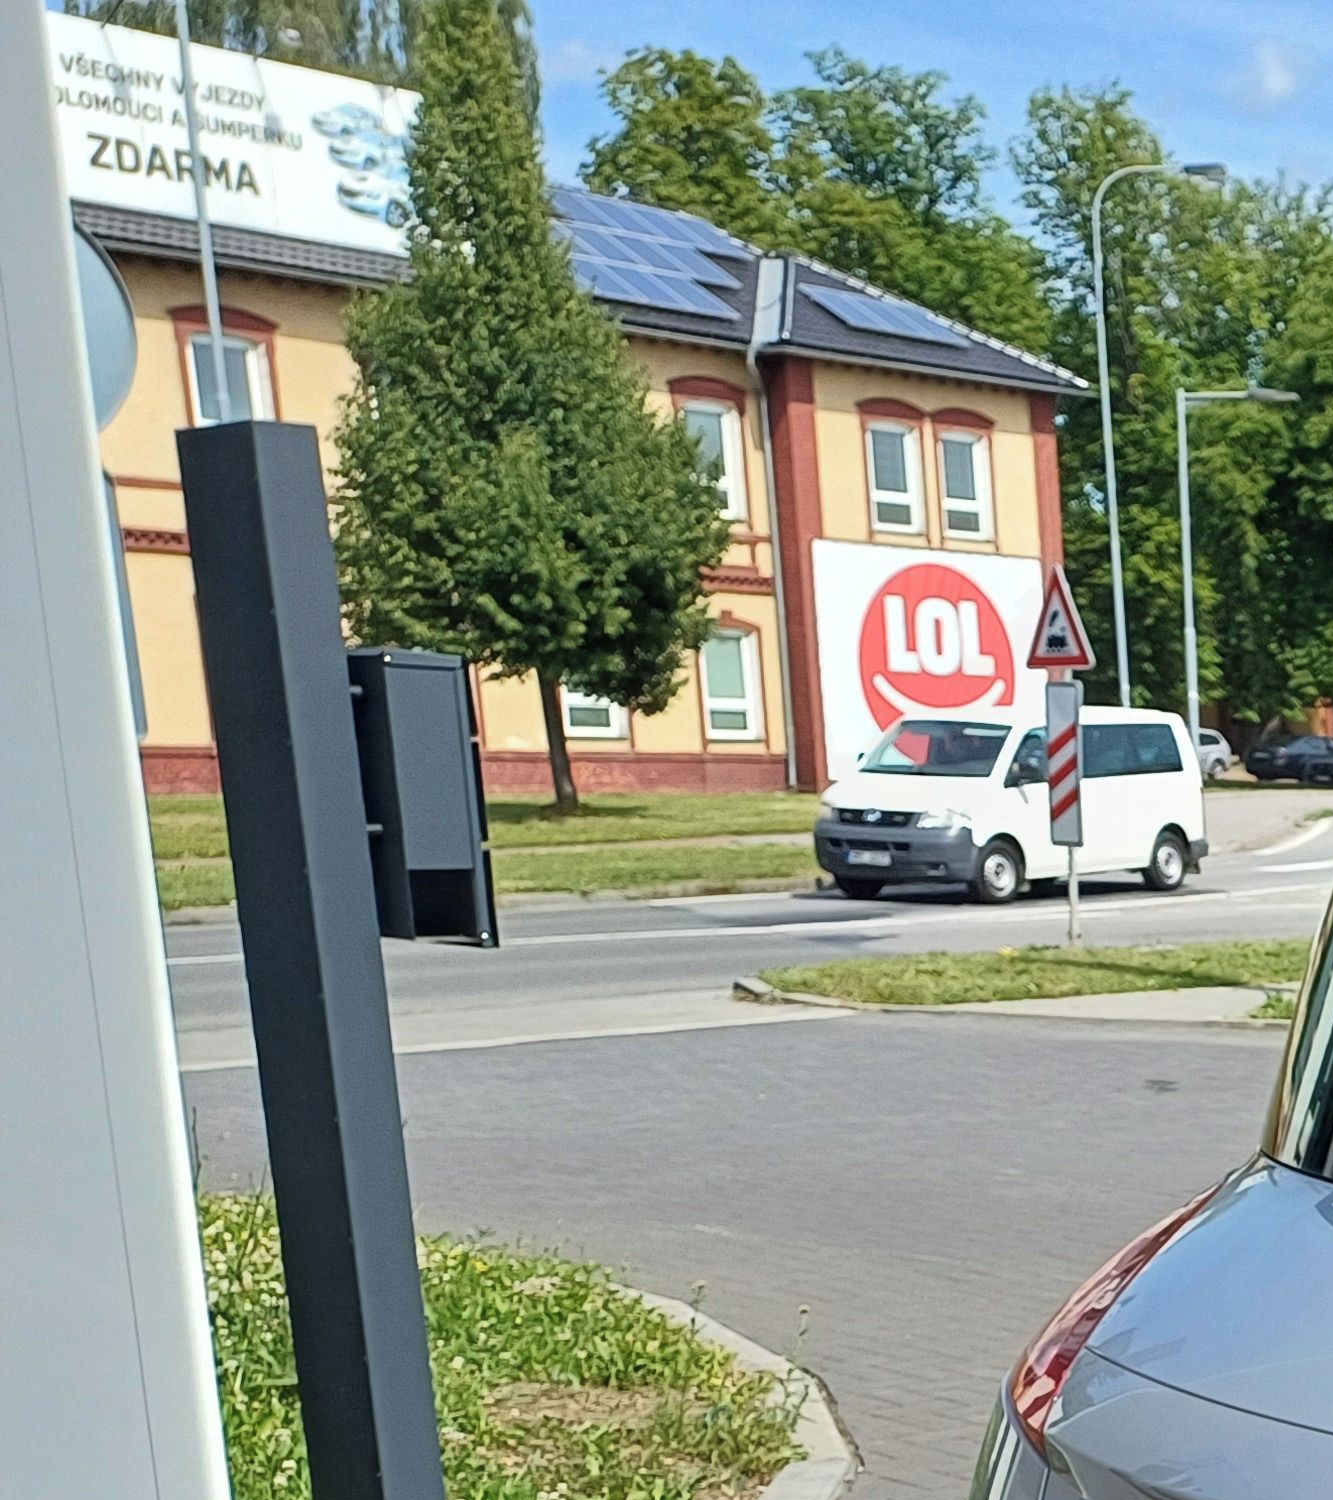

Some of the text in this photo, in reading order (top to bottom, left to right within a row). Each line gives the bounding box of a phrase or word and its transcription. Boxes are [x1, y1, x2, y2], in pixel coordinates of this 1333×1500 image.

[58, 51, 265, 112] VŠECHNY VJEZDY
[171, 108, 187, 127] A
[86, 131, 261, 196] ZDARMA
[883, 594, 996, 677] LOL
